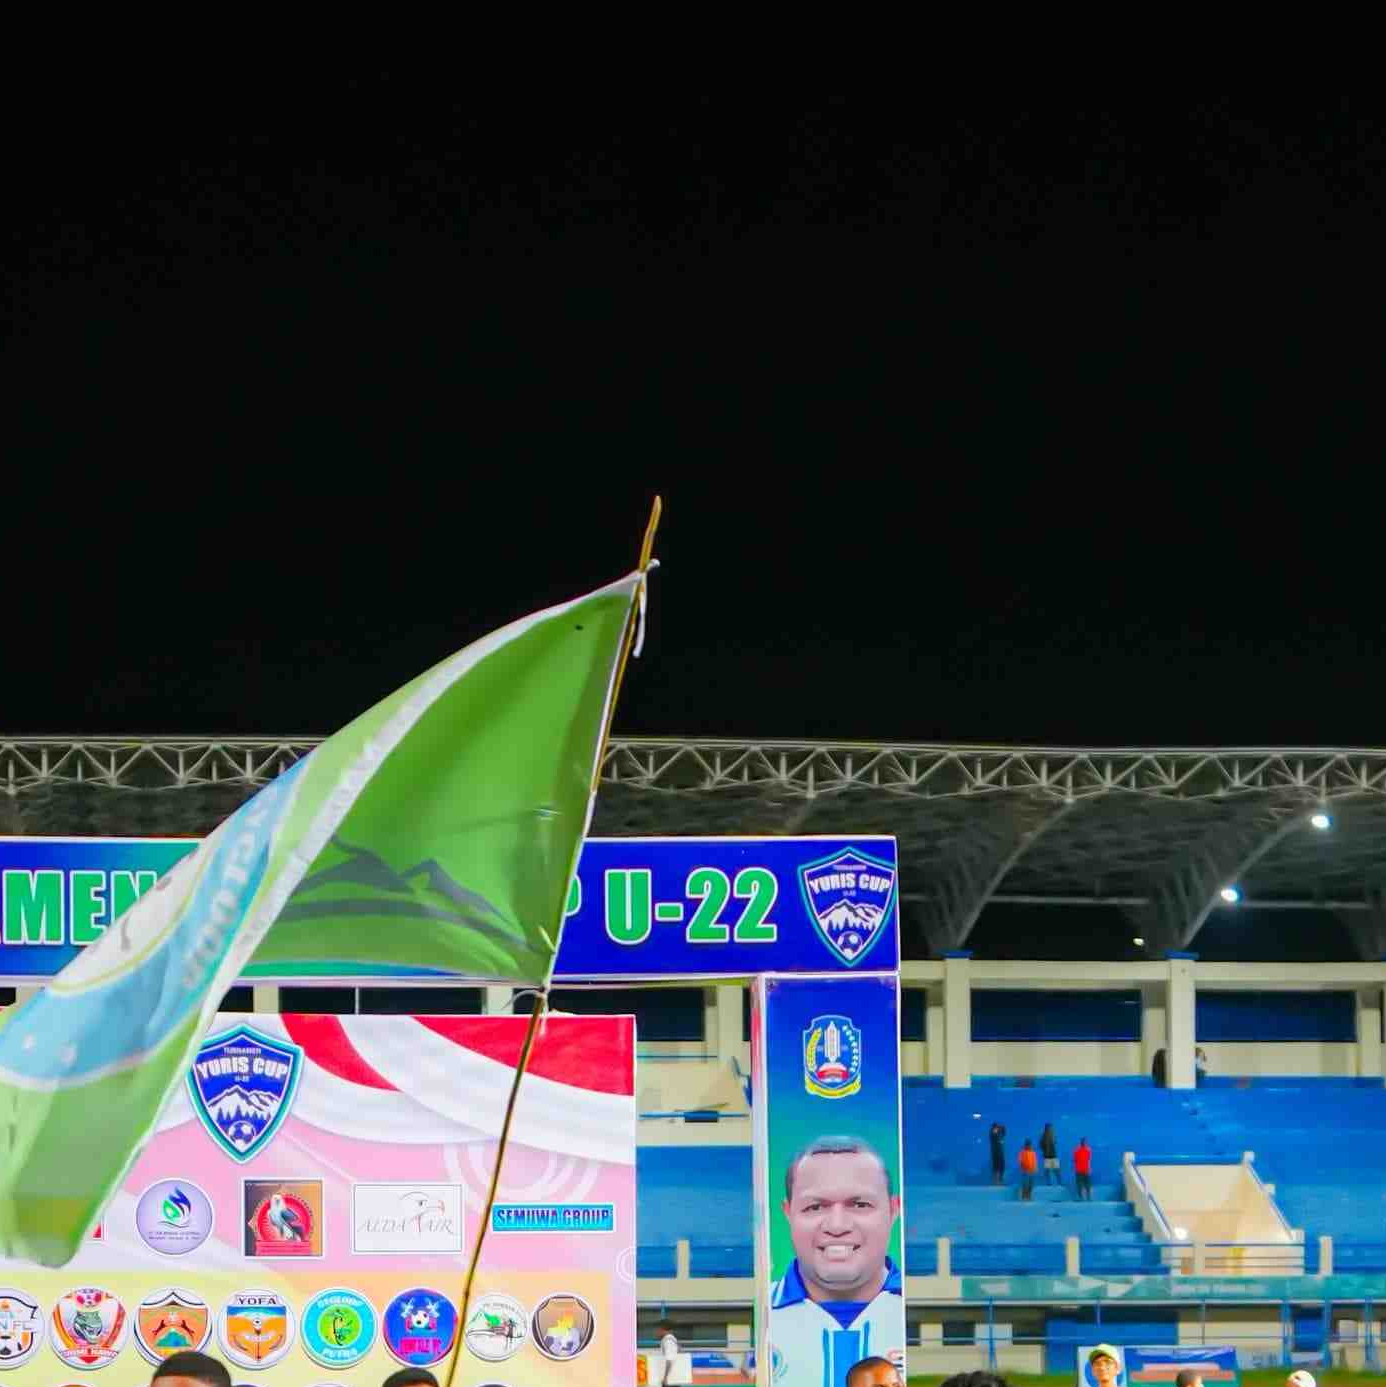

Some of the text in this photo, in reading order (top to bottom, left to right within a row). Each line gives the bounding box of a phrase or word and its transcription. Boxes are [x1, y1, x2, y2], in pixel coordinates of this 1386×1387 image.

[809, 873, 890, 894] YURIS CUP
[604, 866, 779, 945] U-22
[197, 1056, 289, 1079] YURIS CUP
[496, 1209, 610, 1228] SEMUWA GROUP
[237, 1296, 277, 1305] YOFA
